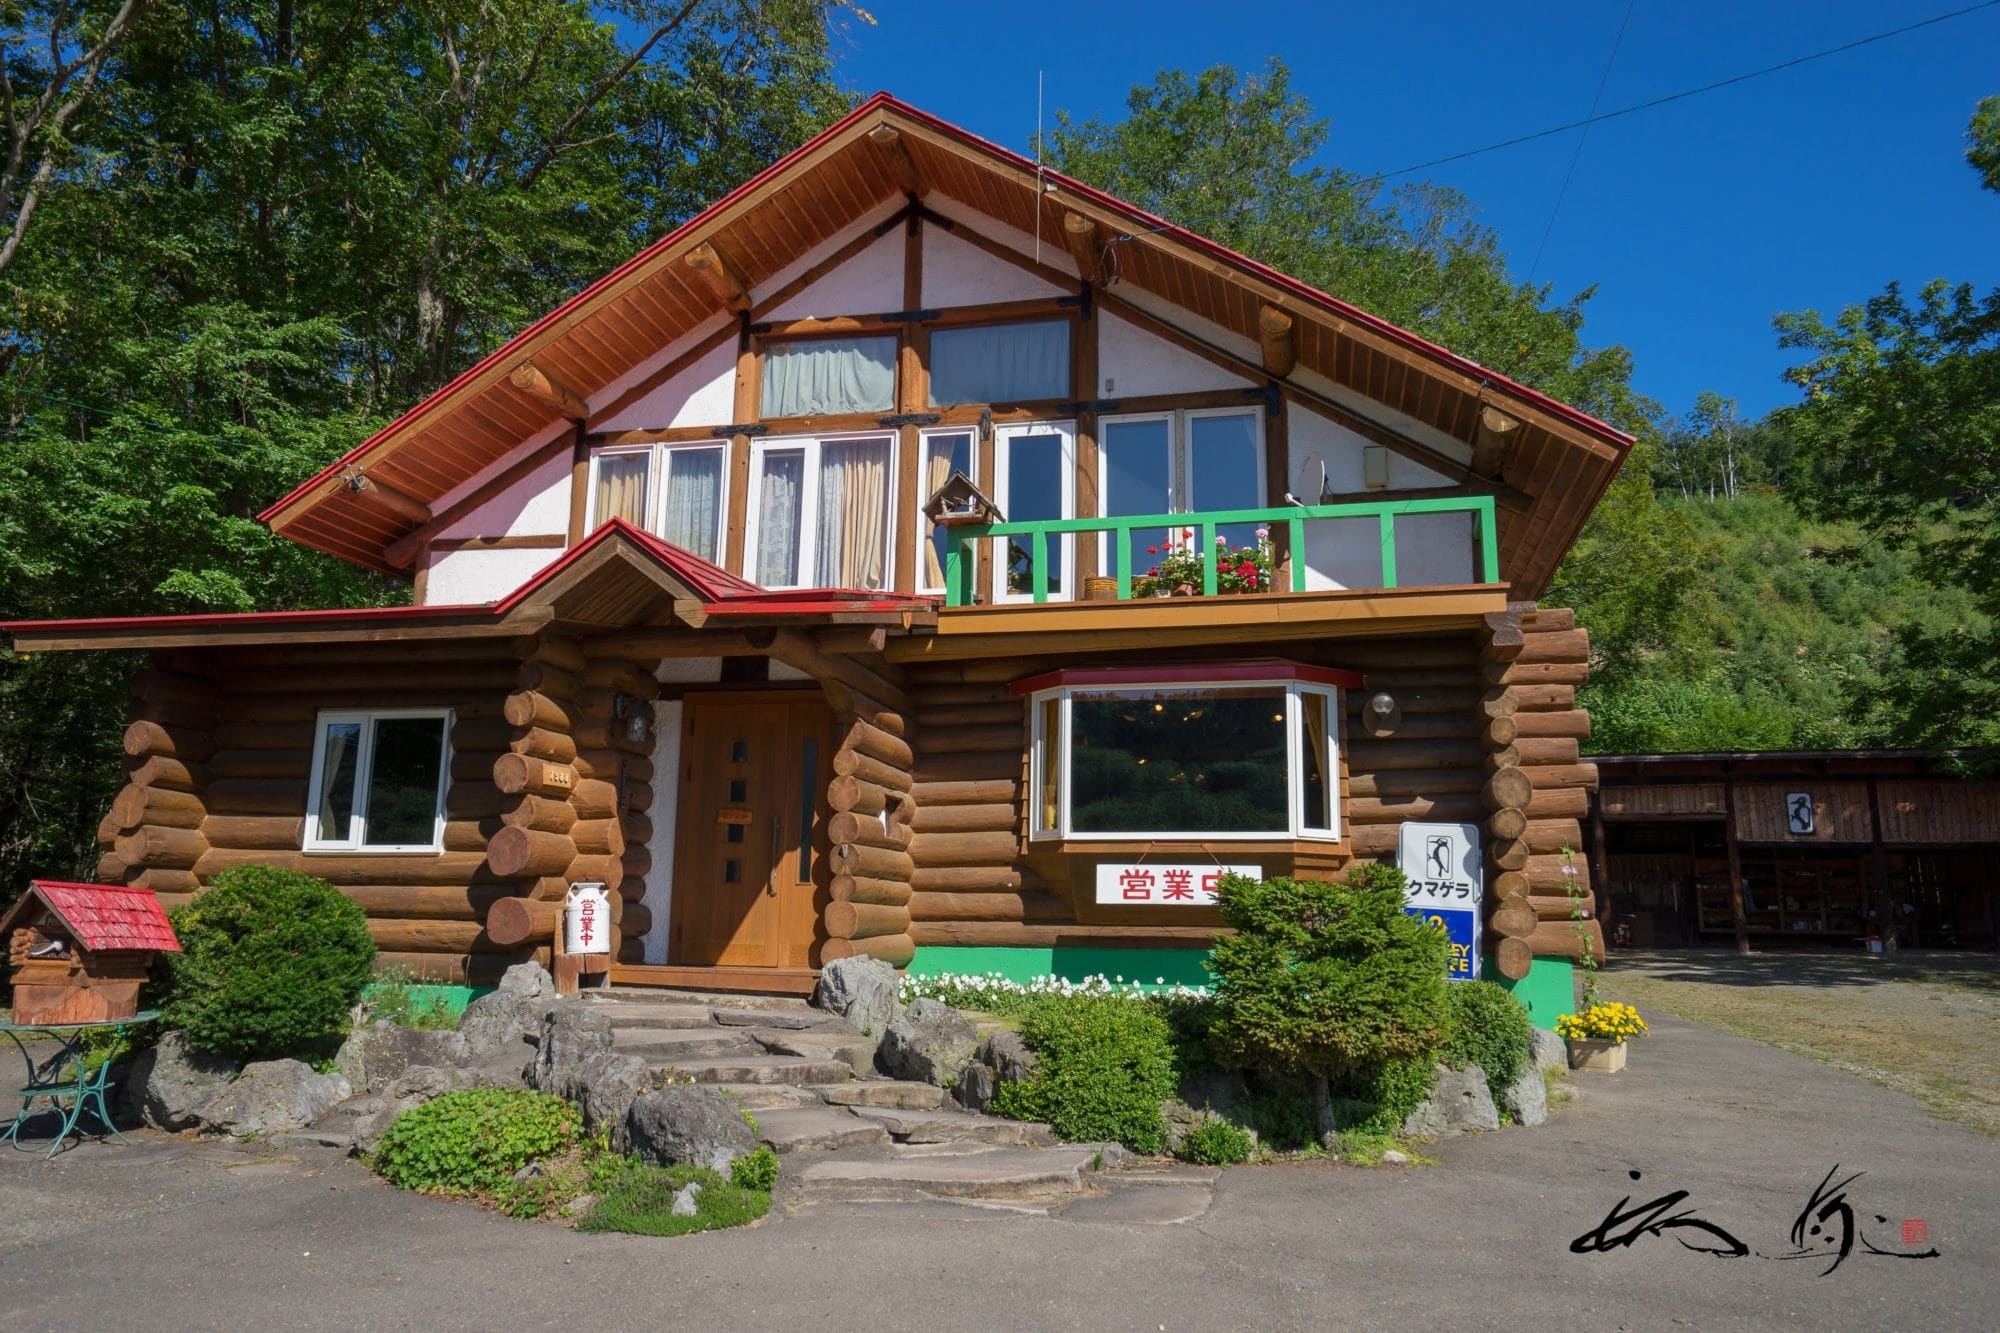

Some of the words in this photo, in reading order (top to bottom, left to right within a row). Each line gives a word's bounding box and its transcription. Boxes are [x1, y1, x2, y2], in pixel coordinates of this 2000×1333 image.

[1409, 880, 1470, 899] クマゲラ
[579, 899, 596, 946] 営業中
